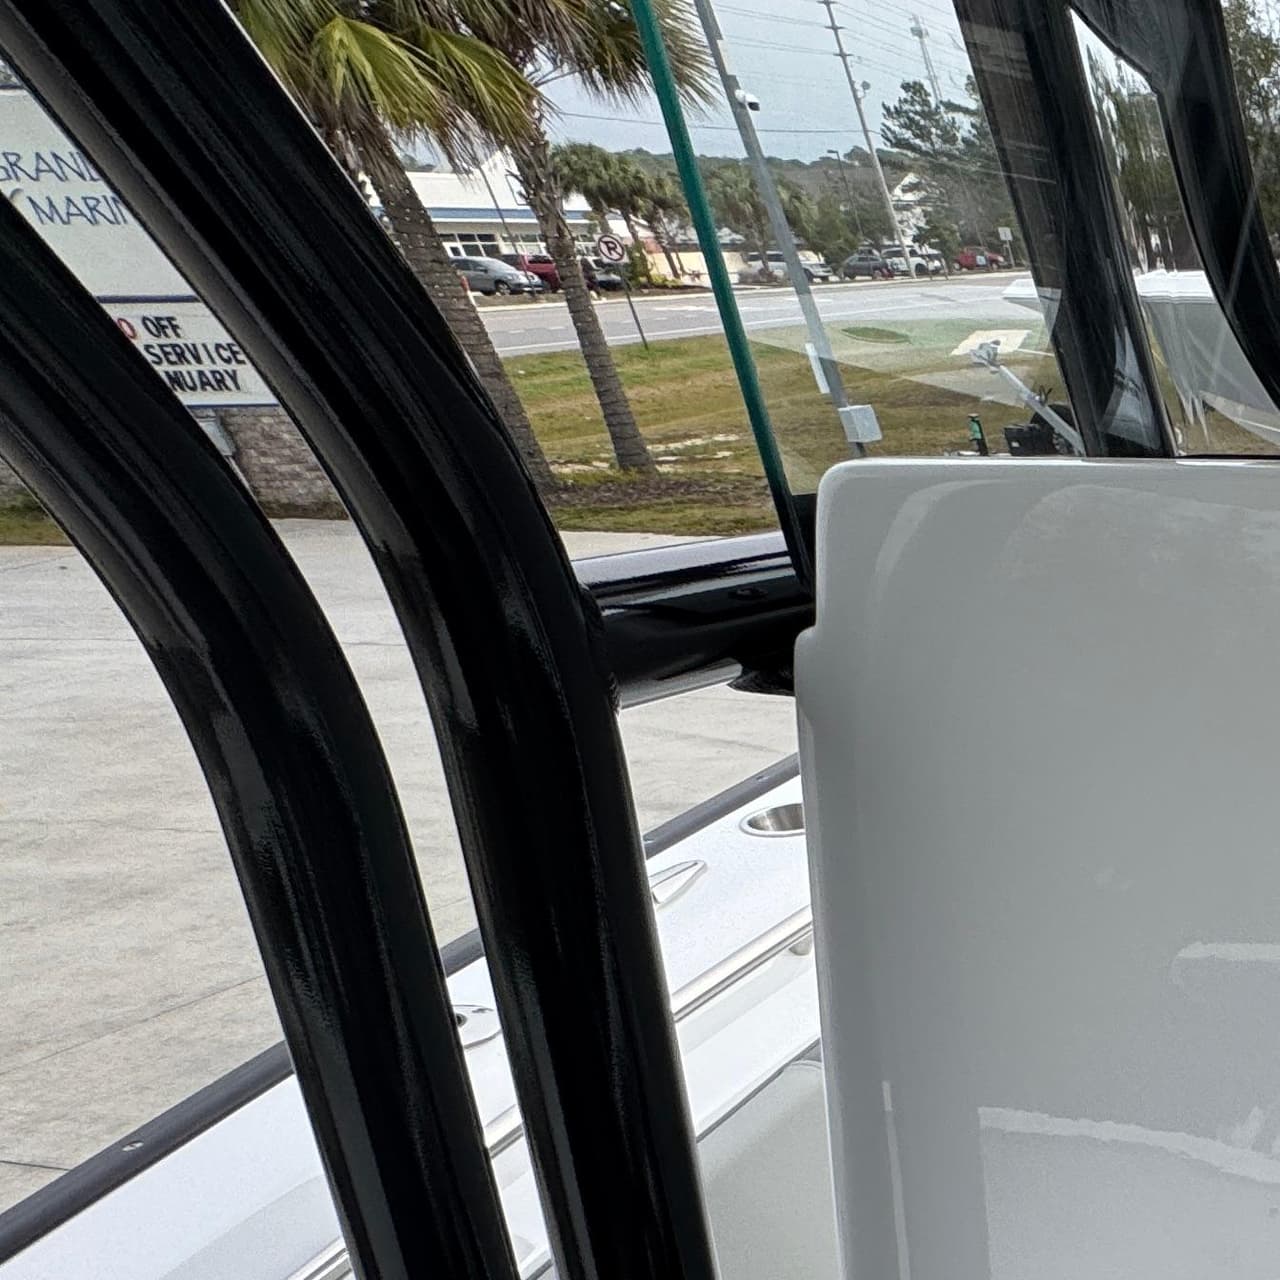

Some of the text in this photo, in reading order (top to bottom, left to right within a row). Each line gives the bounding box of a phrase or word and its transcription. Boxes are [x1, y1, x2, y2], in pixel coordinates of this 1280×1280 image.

[142, 315, 183, 338] OFF
[145, 342, 247, 366] SERVICE
[163, 369, 242, 392] NUARY
